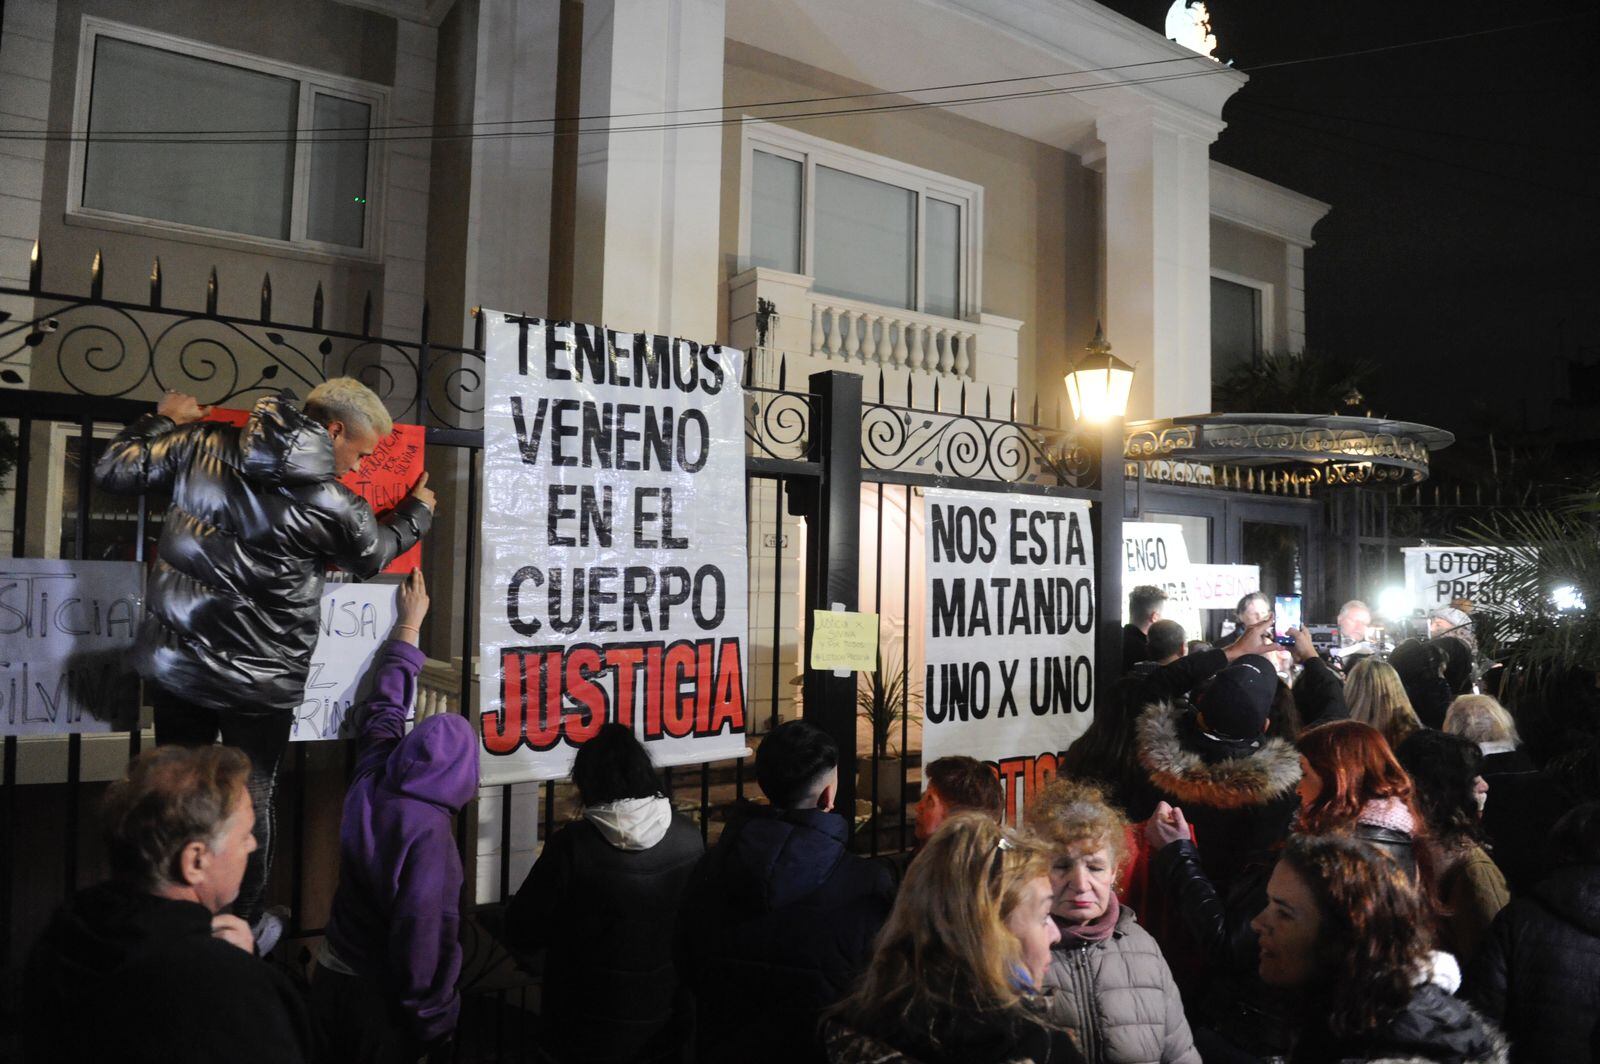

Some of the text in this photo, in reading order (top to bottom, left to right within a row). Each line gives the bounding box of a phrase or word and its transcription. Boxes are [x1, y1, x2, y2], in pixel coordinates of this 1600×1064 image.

[504, 313, 722, 396] TENEMOS
[510, 396, 710, 473] VENENO
[547, 484, 688, 549] EN EL
[931, 504, 1086, 566] NOS ESTA
[506, 563, 726, 638] CUERPO
[931, 577, 1094, 638] MATANDO
[481, 637, 746, 756] JUSTICIA
[926, 655, 1093, 724] UNO X UNO
